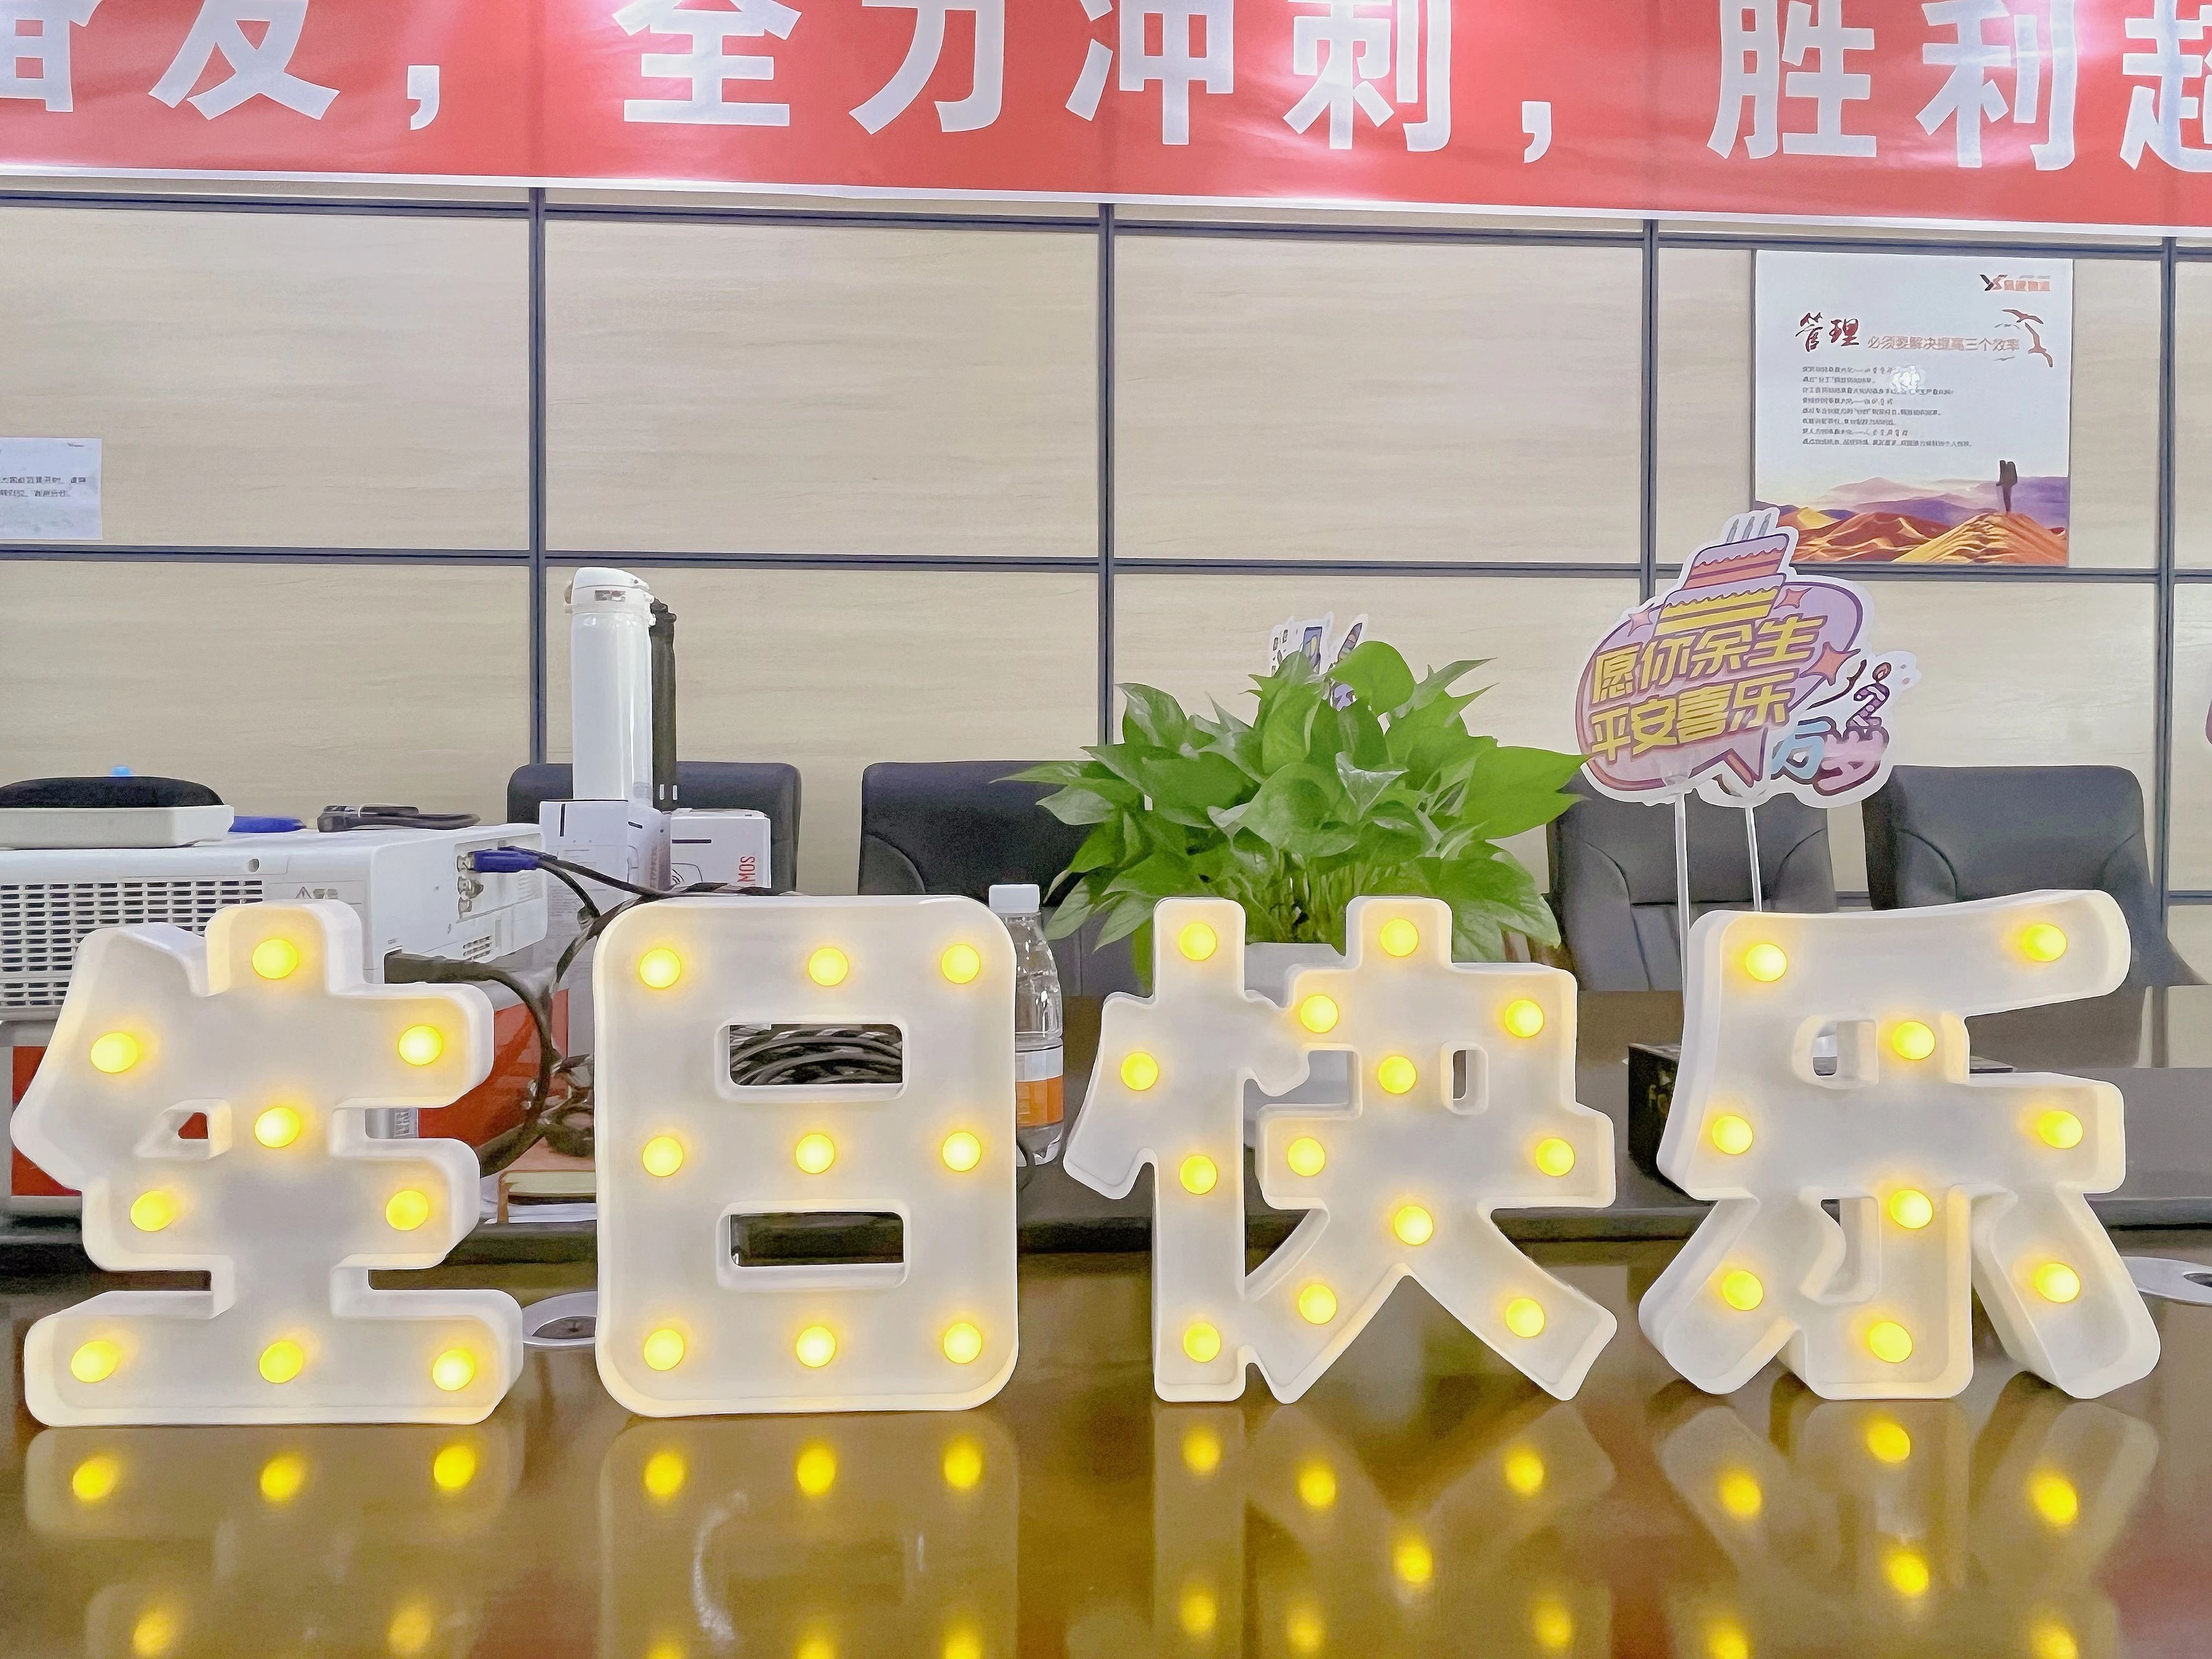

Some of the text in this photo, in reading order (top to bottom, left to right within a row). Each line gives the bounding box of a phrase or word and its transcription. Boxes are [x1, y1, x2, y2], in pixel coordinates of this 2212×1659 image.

[1796, 312, 1859, 352] 管理
[1591, 613, 1824, 704] 愿你余生
[1590, 669, 1797, 761] 平安喜乐
[738, 856, 755, 887] MOS
[10, 888, 2162, 1427] 生日快乐
